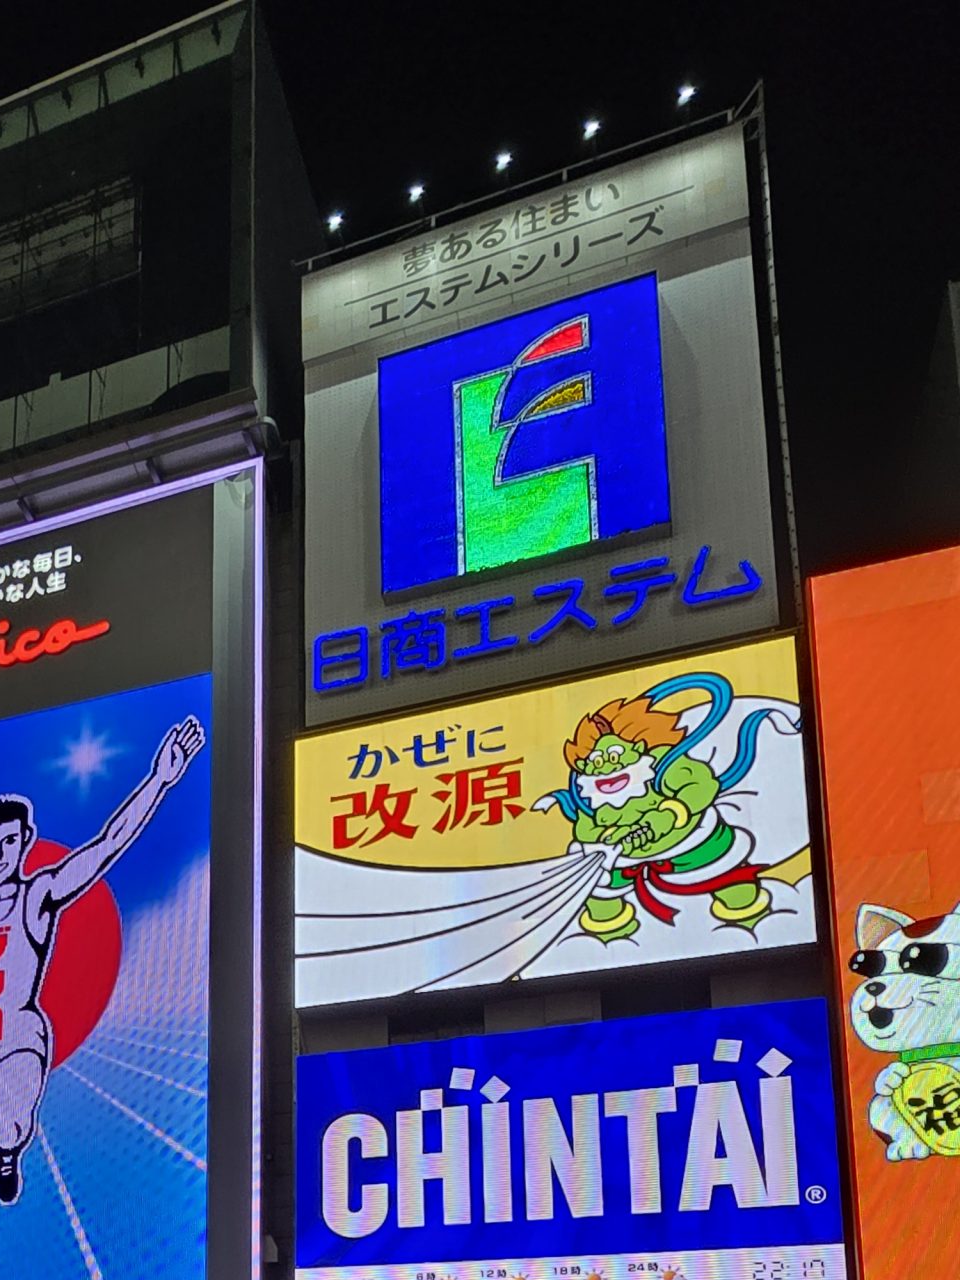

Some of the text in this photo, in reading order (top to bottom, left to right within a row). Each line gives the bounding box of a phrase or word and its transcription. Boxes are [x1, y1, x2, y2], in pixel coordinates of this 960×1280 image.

[369, 204, 670, 330] エステムシリーズ
[402, 183, 622, 277] 夢ある住まい
[312, 544, 763, 693] 日商エステム
[347, 723, 507, 780] かぜに
[330, 756, 530, 850] 改源
